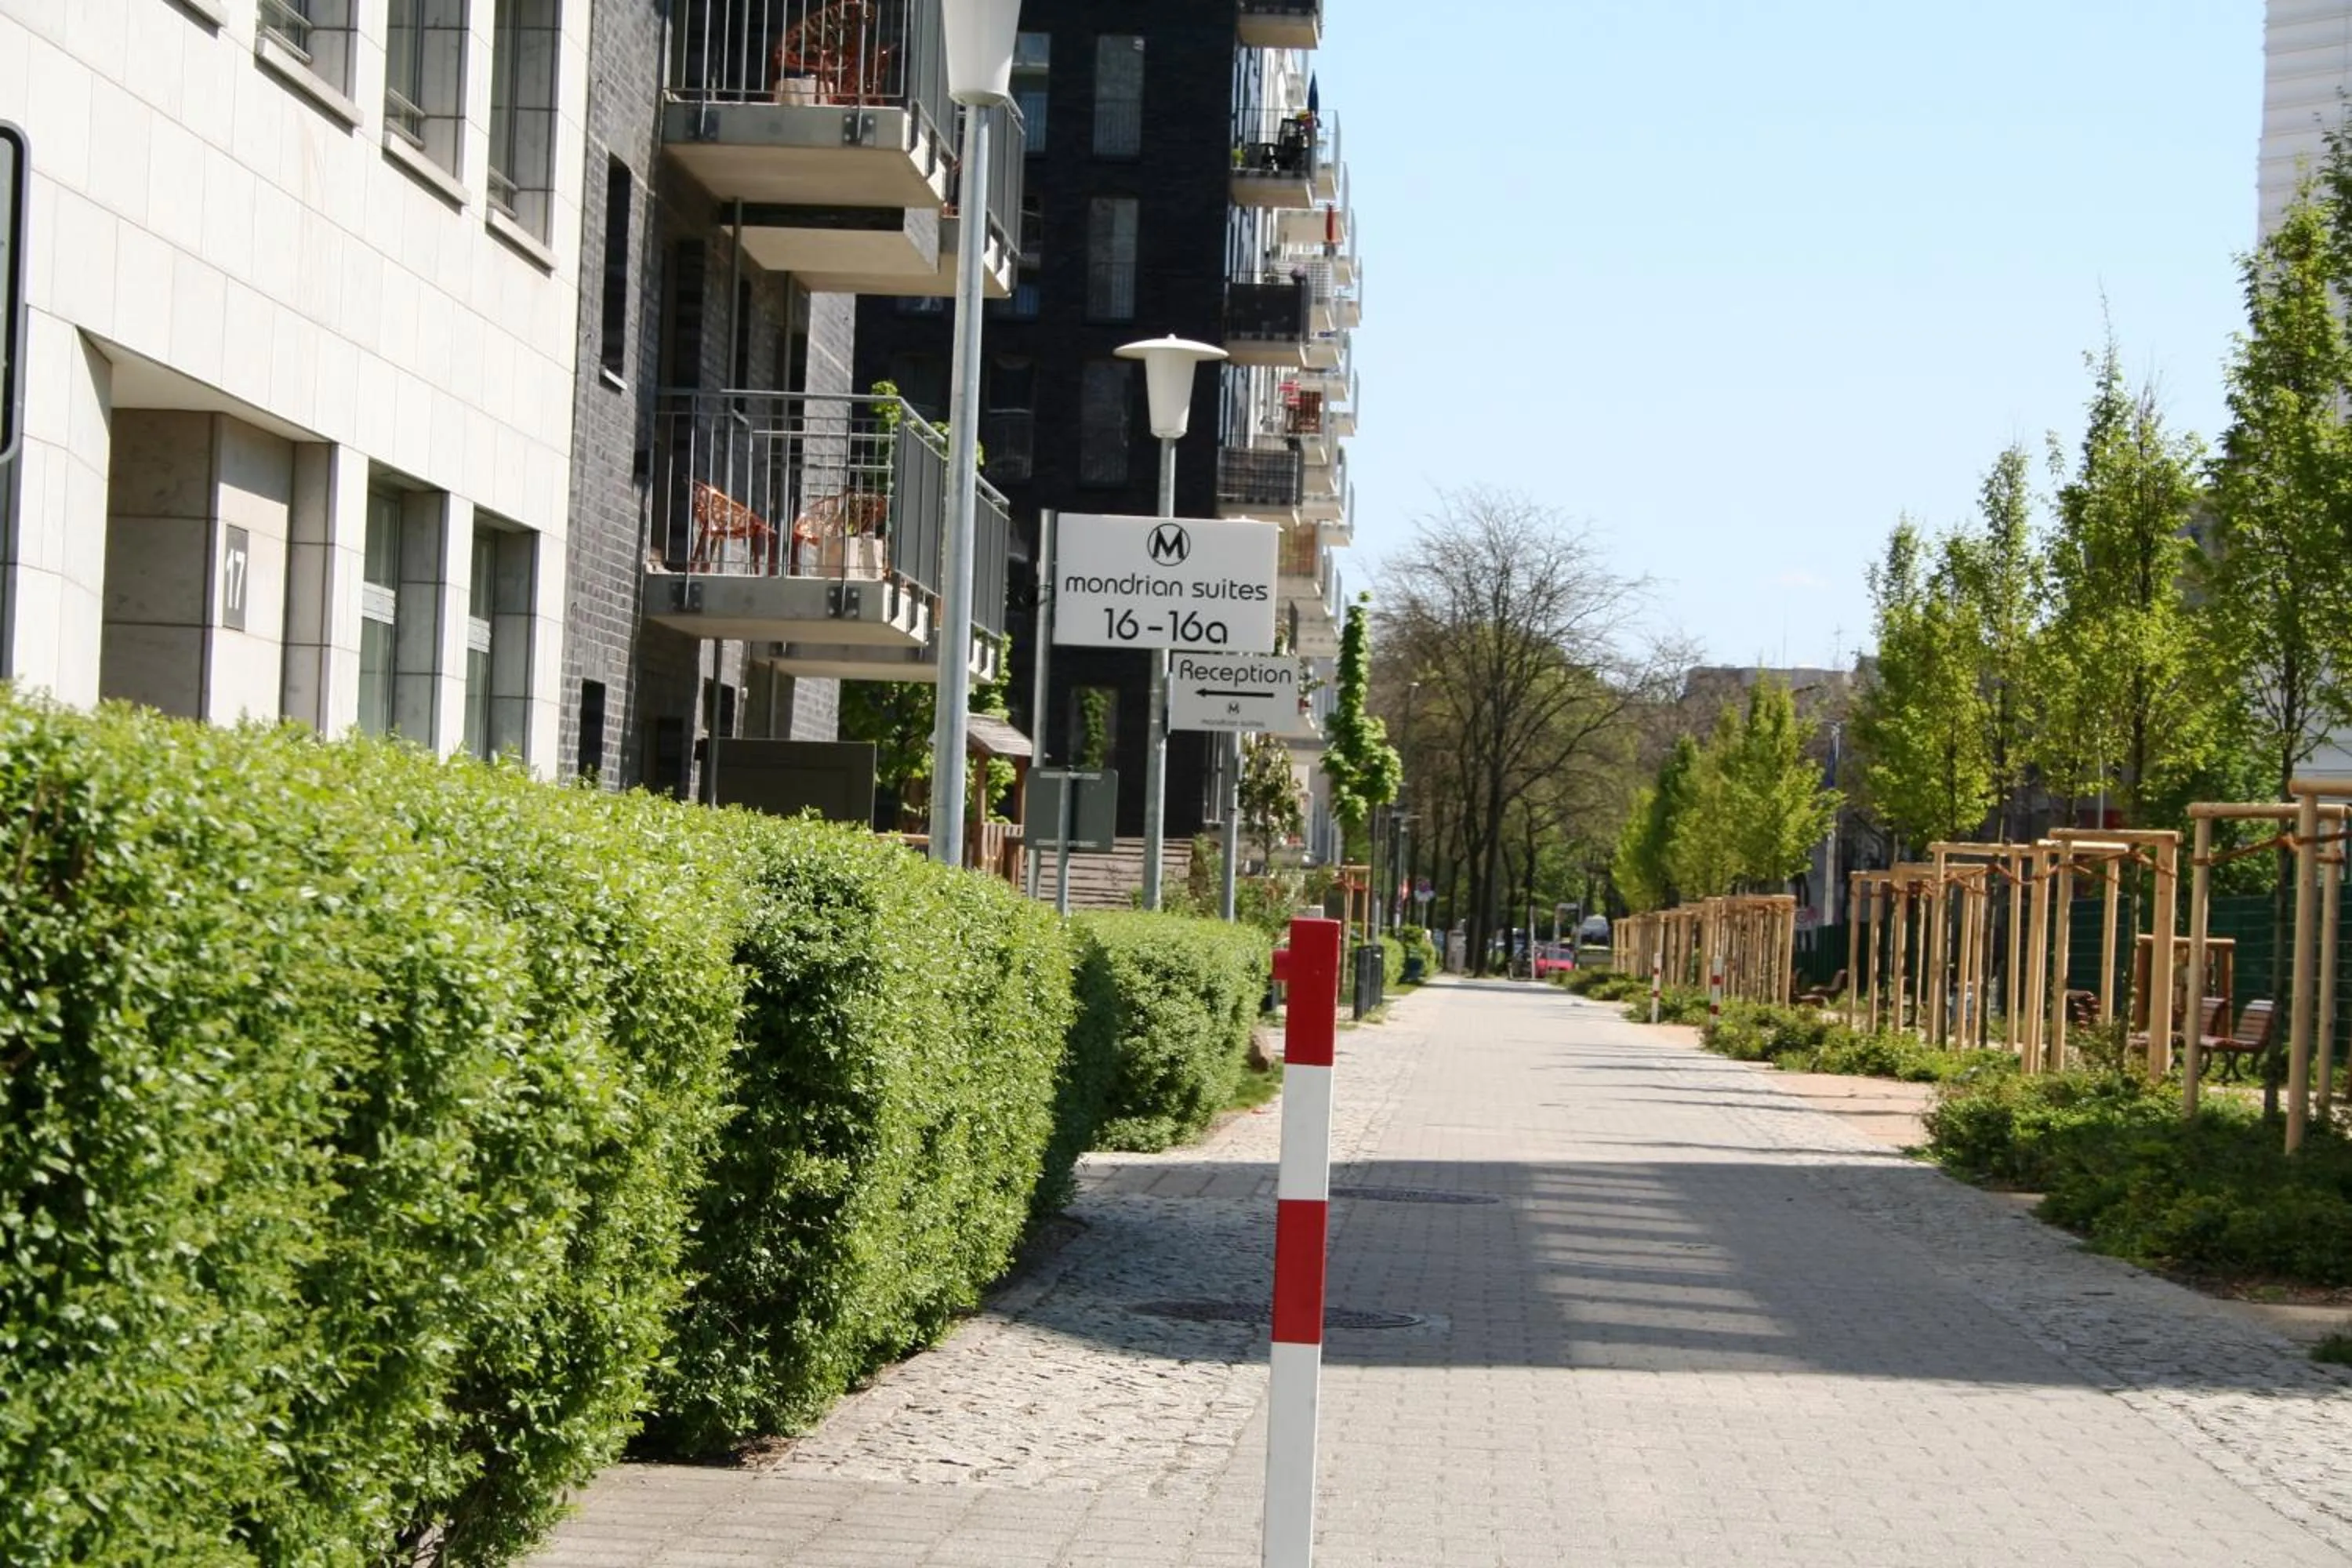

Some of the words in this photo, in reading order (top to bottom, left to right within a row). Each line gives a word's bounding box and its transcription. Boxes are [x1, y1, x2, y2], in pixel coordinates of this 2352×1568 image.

[1151, 527, 1188, 561] M
[227, 548, 246, 610] 17
[1065, 572, 1183, 597] mondrian
[1191, 579, 1269, 601] suites
[1178, 659, 1292, 688] Reception
